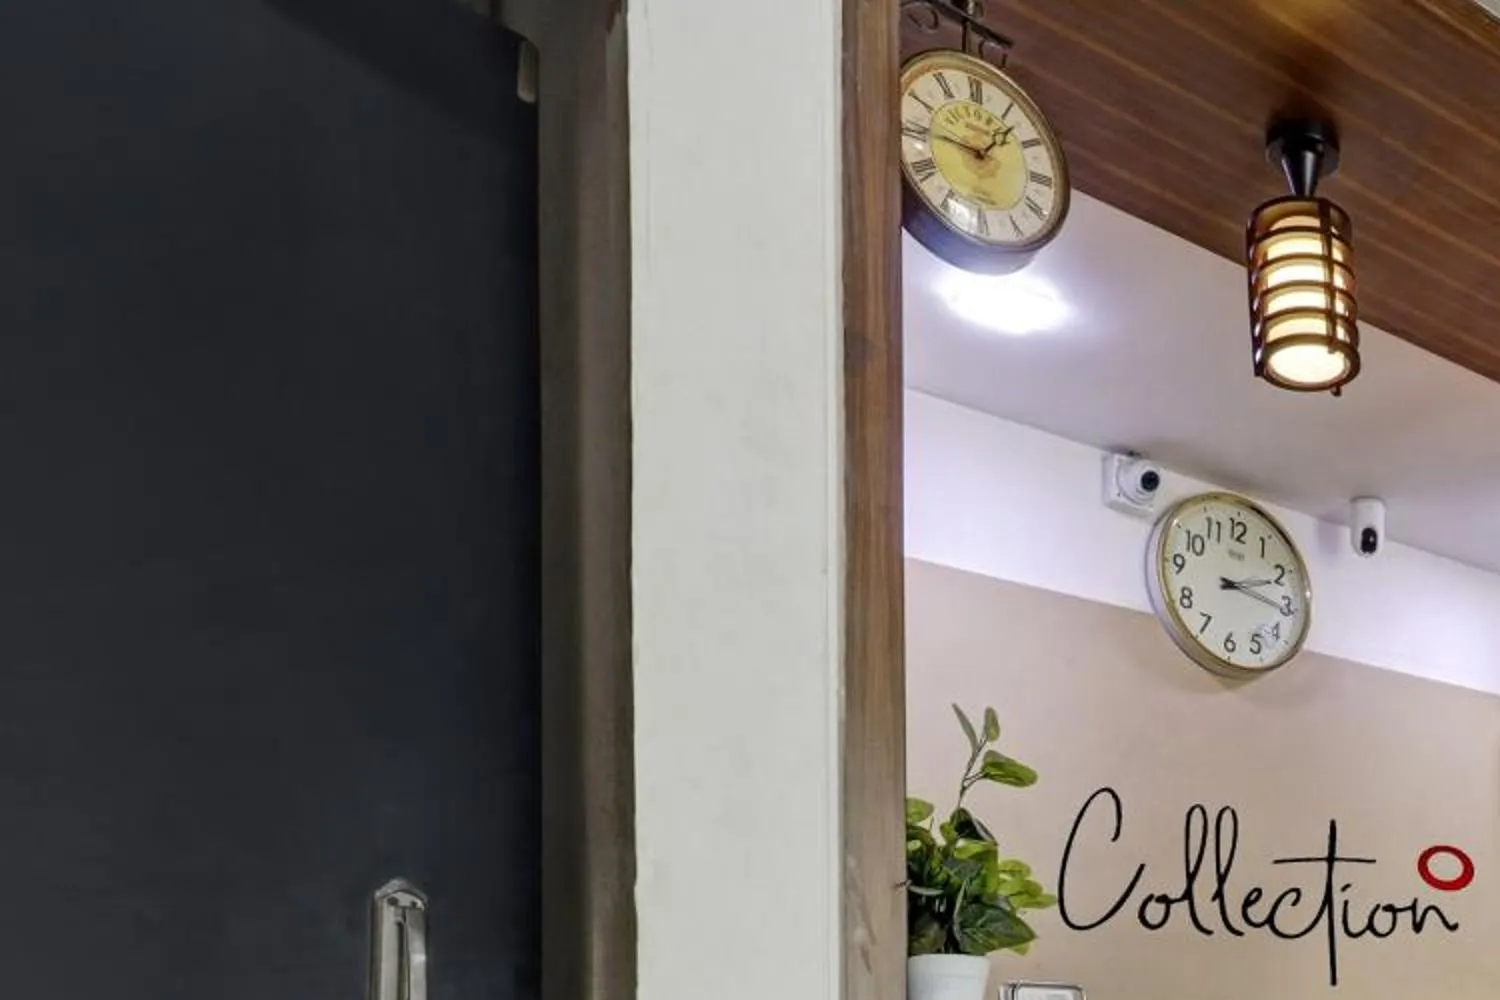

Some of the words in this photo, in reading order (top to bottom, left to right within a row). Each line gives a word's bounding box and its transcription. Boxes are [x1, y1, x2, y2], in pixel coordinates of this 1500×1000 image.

[1206, 516, 1221, 544] 11
[1229, 517, 1248, 545] 12
[1186, 530, 1205, 556] 10
[1259, 536, 1266, 559] 1
[1173, 554, 1186, 575] 9
[1273, 564, 1286, 586] 2
[1179, 586, 1193, 609] 8
[1200, 612, 1212, 635] 7
[1223, 632, 1236, 653] 6
[1249, 634, 1263, 655] 5
[1059, 787, 1459, 987] Collection
